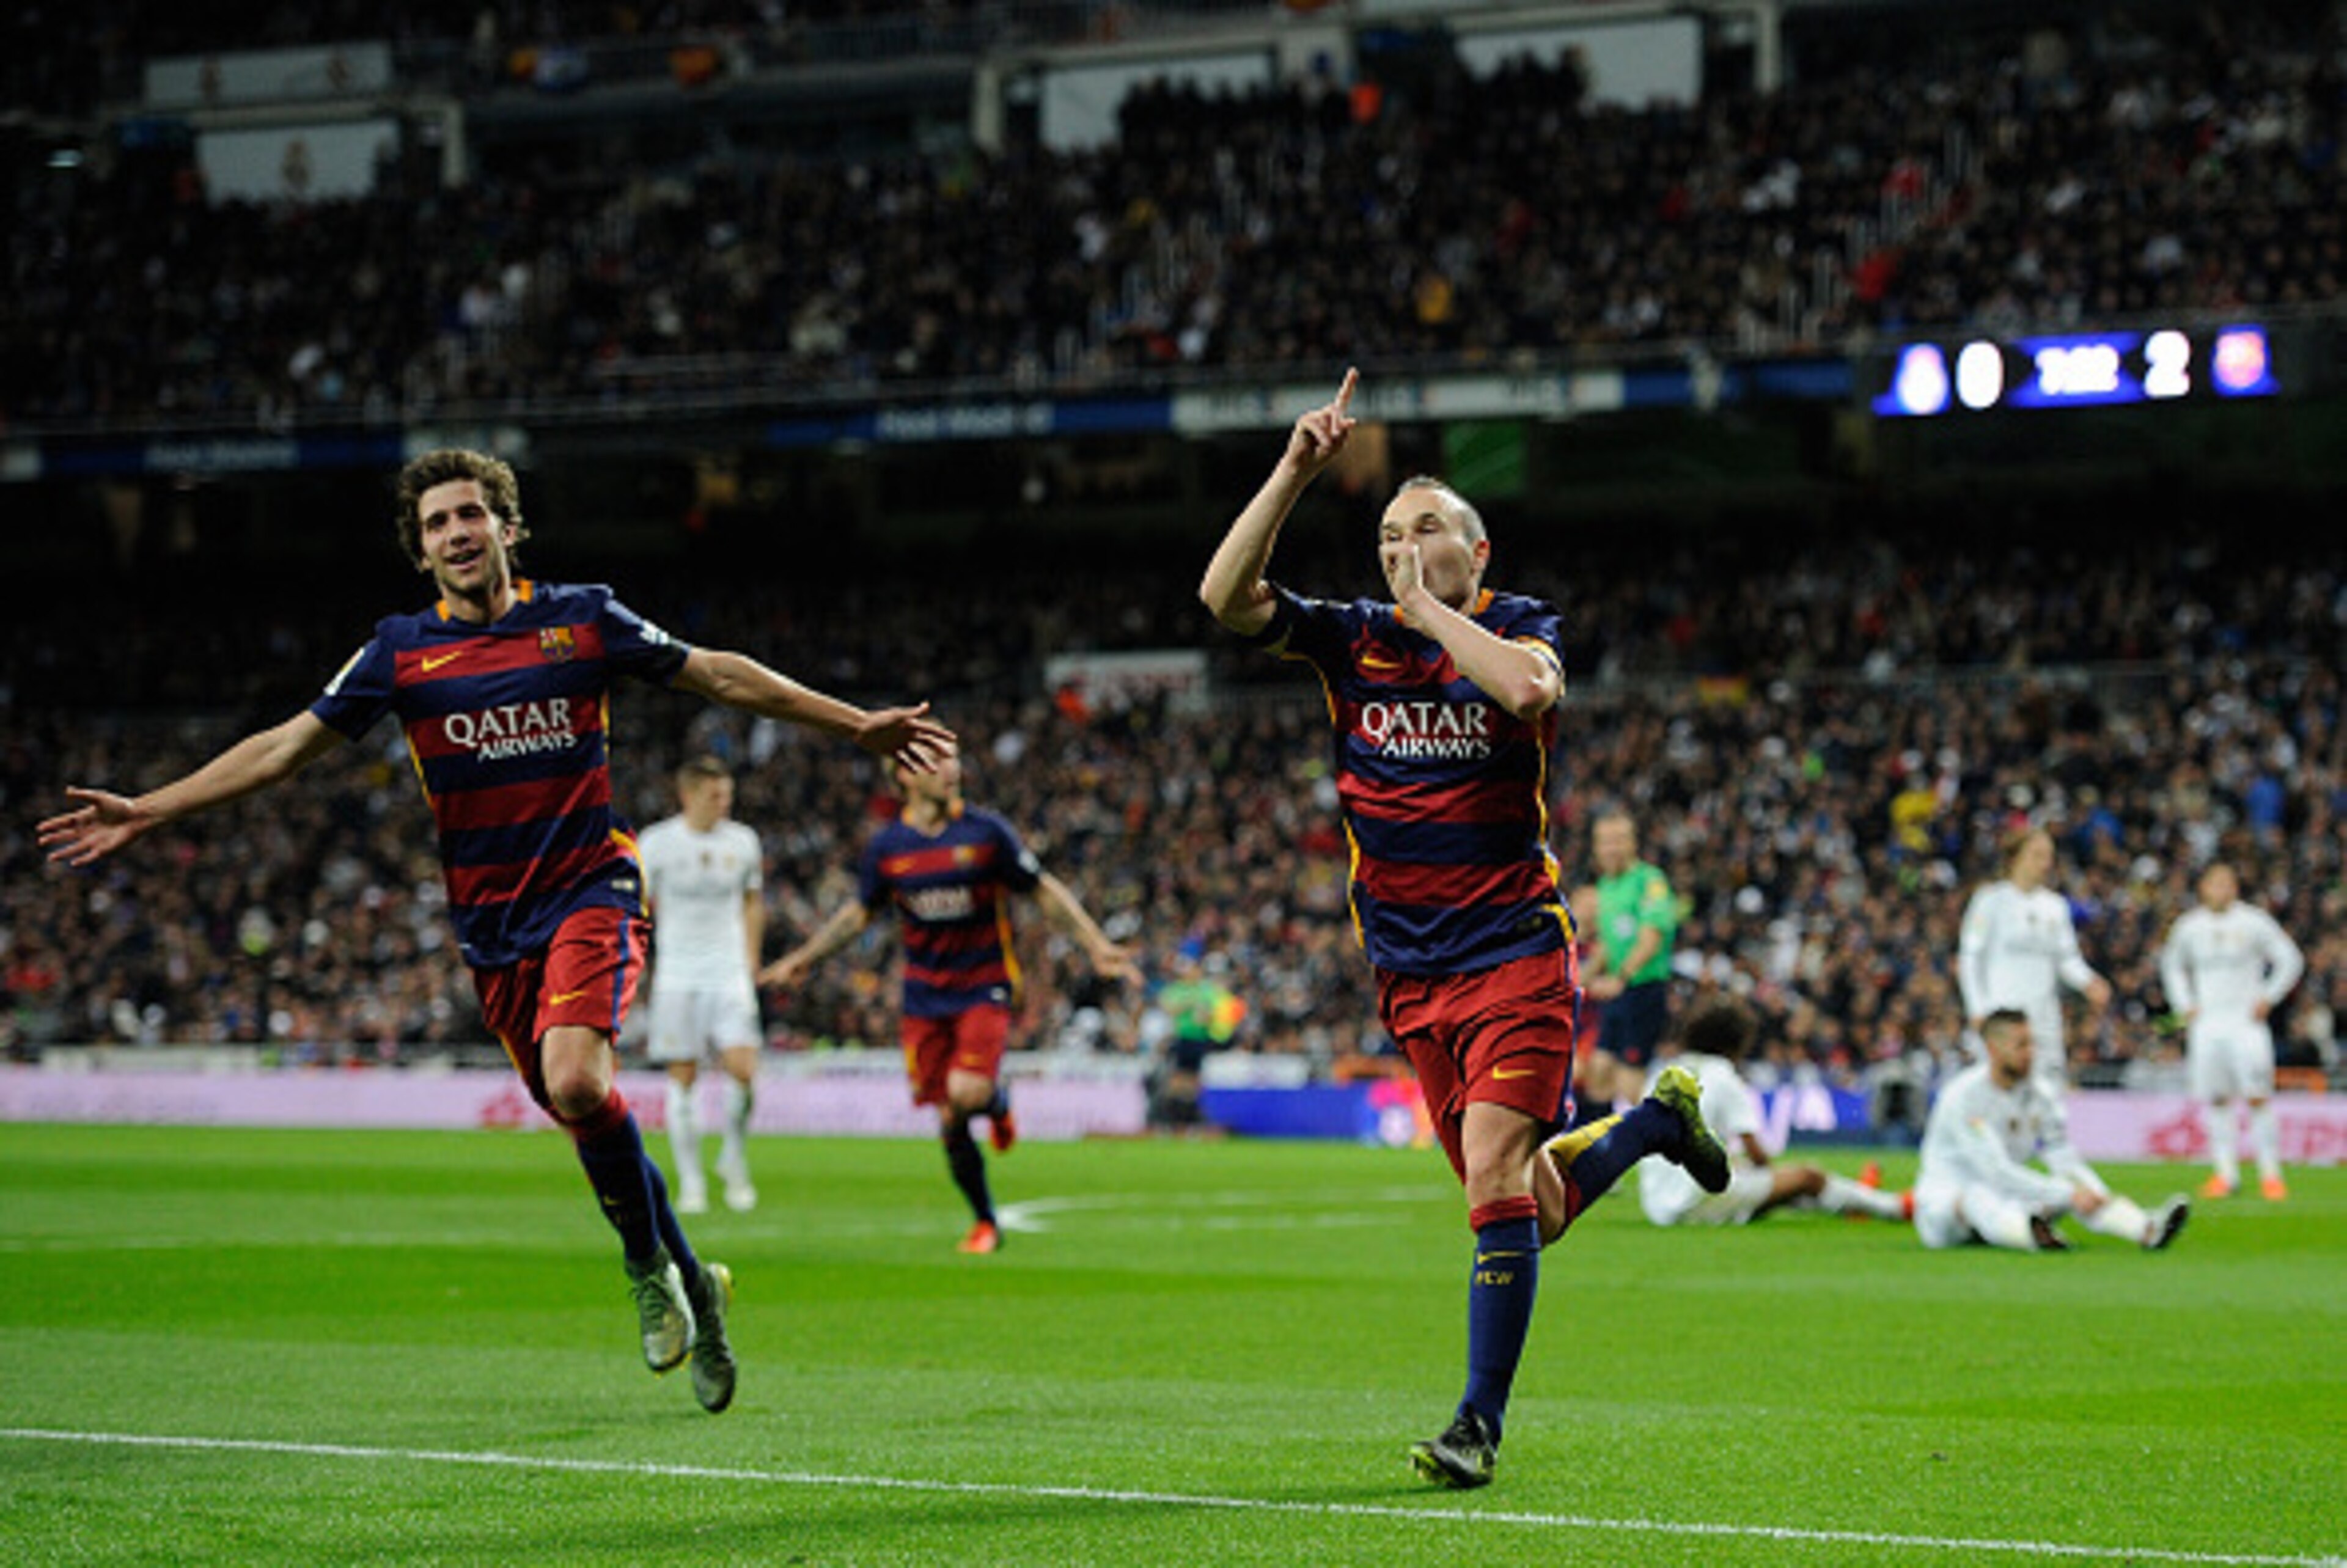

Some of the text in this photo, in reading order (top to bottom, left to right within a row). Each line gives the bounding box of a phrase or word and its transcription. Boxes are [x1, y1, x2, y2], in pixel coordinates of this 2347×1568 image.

[1957, 341, 2003, 409] 0
[2145, 331, 2190, 397] 2
[444, 698, 571, 749] QATAR
[1362, 702, 1488, 743] QATAR
[477, 731, 577, 763] AIRWAYS
[1382, 736, 1491, 759] AIRWAYS
